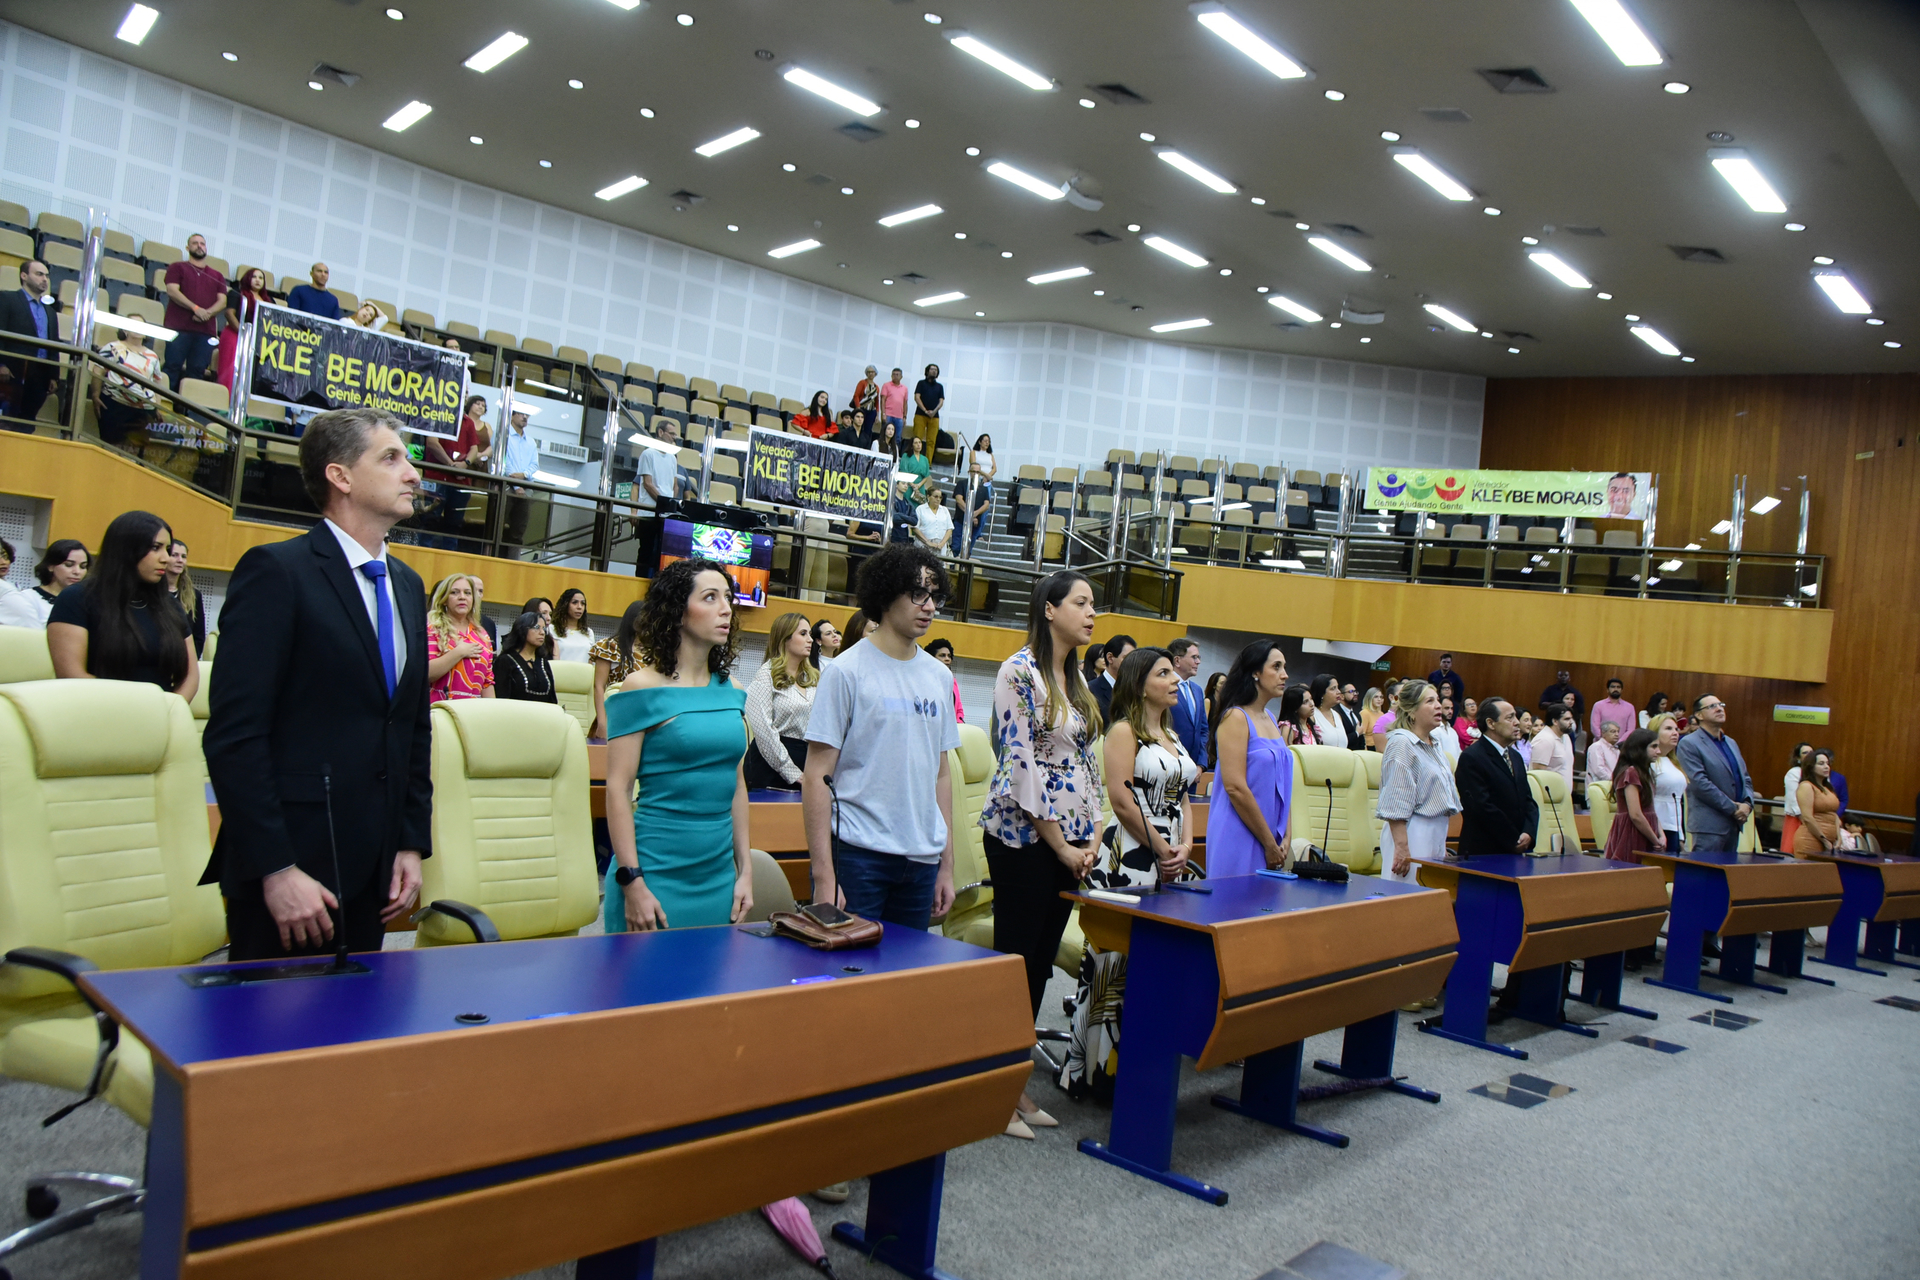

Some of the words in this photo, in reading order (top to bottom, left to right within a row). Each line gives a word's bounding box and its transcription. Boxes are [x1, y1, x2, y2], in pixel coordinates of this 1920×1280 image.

[262, 317, 323, 347] Vereador
[365, 362, 460, 409] MORAIS
[326, 384, 362, 405] Gente
[363, 393, 419, 417] Ajudando
[420, 404, 456, 424] Gente
[754, 440, 794, 459] Vereador
[822, 469, 888, 501] MORAIS
[1471, 488, 1535, 505] KLEYBE
[1537, 490, 1604, 506] MORAIS
[1473, 479, 1510, 488] Vereador
[797, 486, 820, 502] Gente
[821, 493, 859, 509] Ajudando
[860, 500, 886, 513] Gente
[1374, 498, 1397, 508] Gente
[1399, 500, 1438, 510] Ajudando
[1439, 501, 1464, 511] Gente
